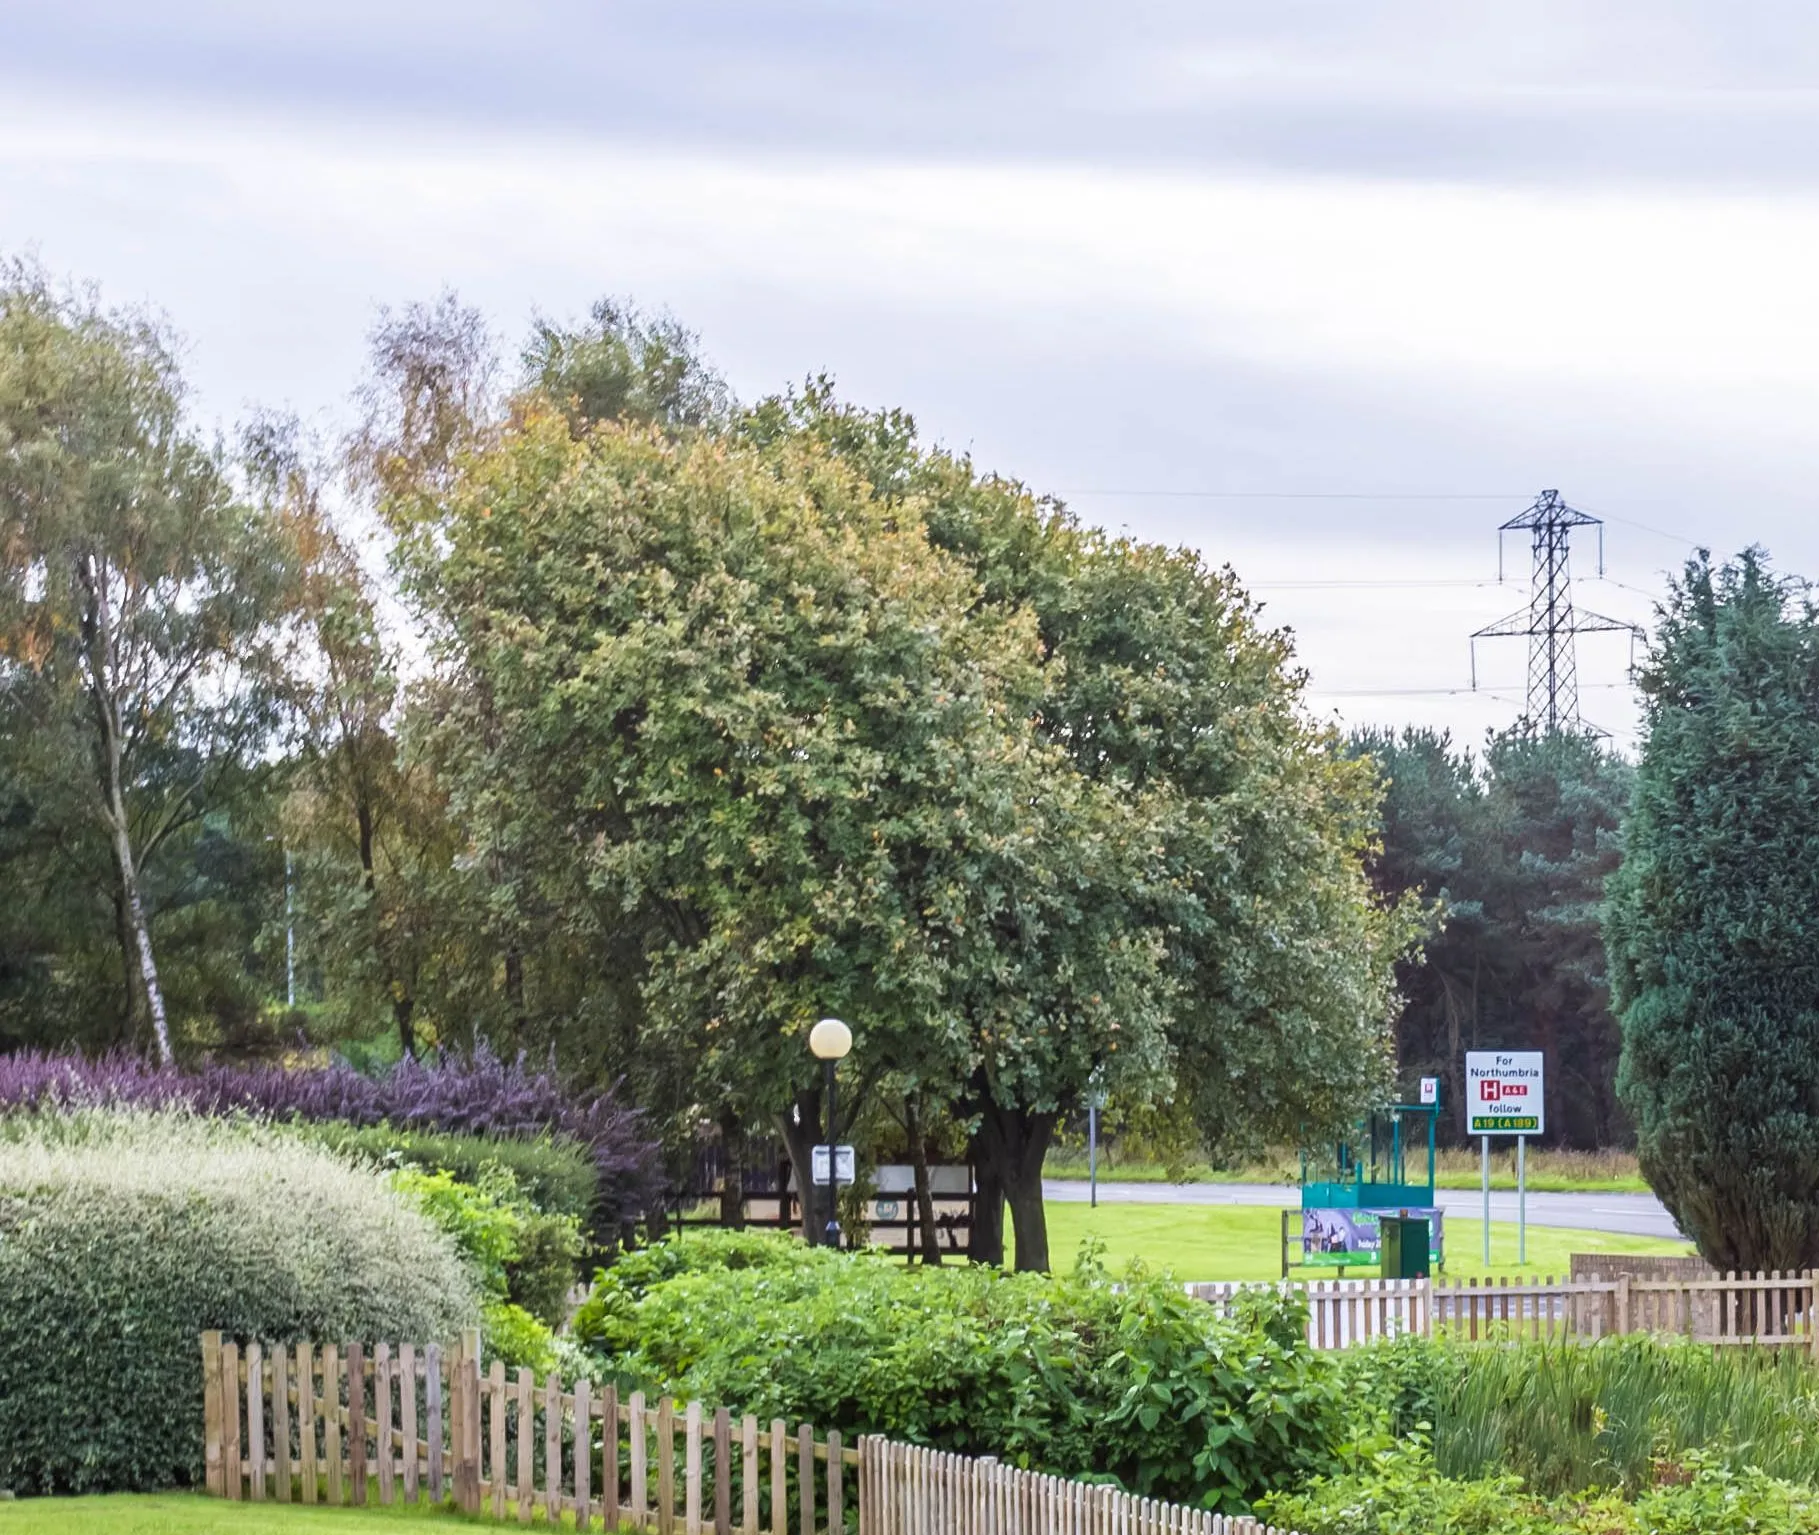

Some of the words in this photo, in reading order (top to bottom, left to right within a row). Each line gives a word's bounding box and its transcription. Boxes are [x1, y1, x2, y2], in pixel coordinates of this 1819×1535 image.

[1496, 1056, 1512, 1065] For
[1470, 1068, 1539, 1077] Northumbria
[1483, 1081, 1498, 1099] H
[1489, 1104, 1521, 1113] follow
